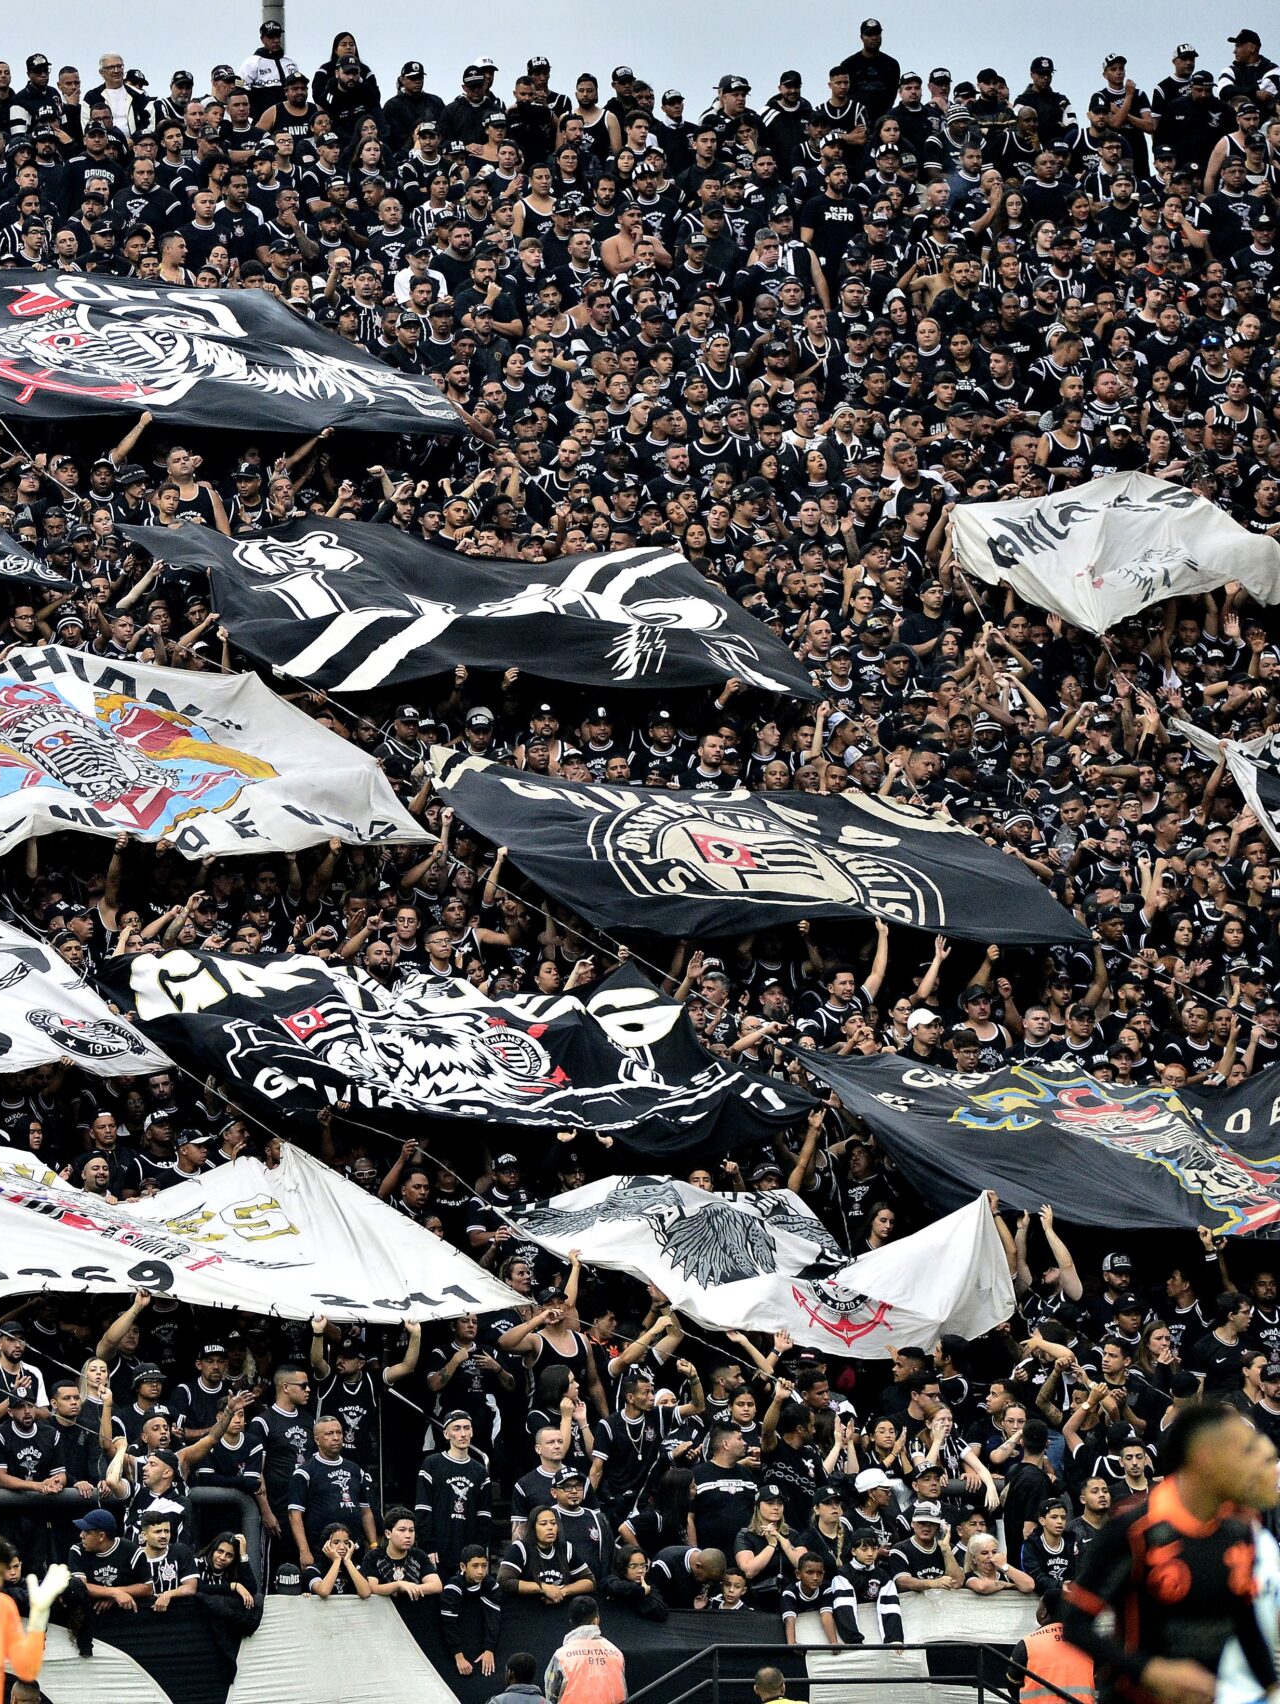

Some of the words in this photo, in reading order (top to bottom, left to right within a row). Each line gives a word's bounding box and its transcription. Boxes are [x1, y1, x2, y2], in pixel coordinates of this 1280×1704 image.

[824, 213, 854, 221] PRETO
[835, 1300, 856, 1310] 1910
[338, 1406, 368, 1415] GAVIÕES
[284, 1426, 309, 1438] GAVIÕES
[17, 1445, 42, 1458] GAVIÕES
[327, 1469, 351, 1479] GAVIÕES
[445, 1475, 474, 1487] GAVIÕES
[93, 1566, 119, 1577] GAVIÕES
